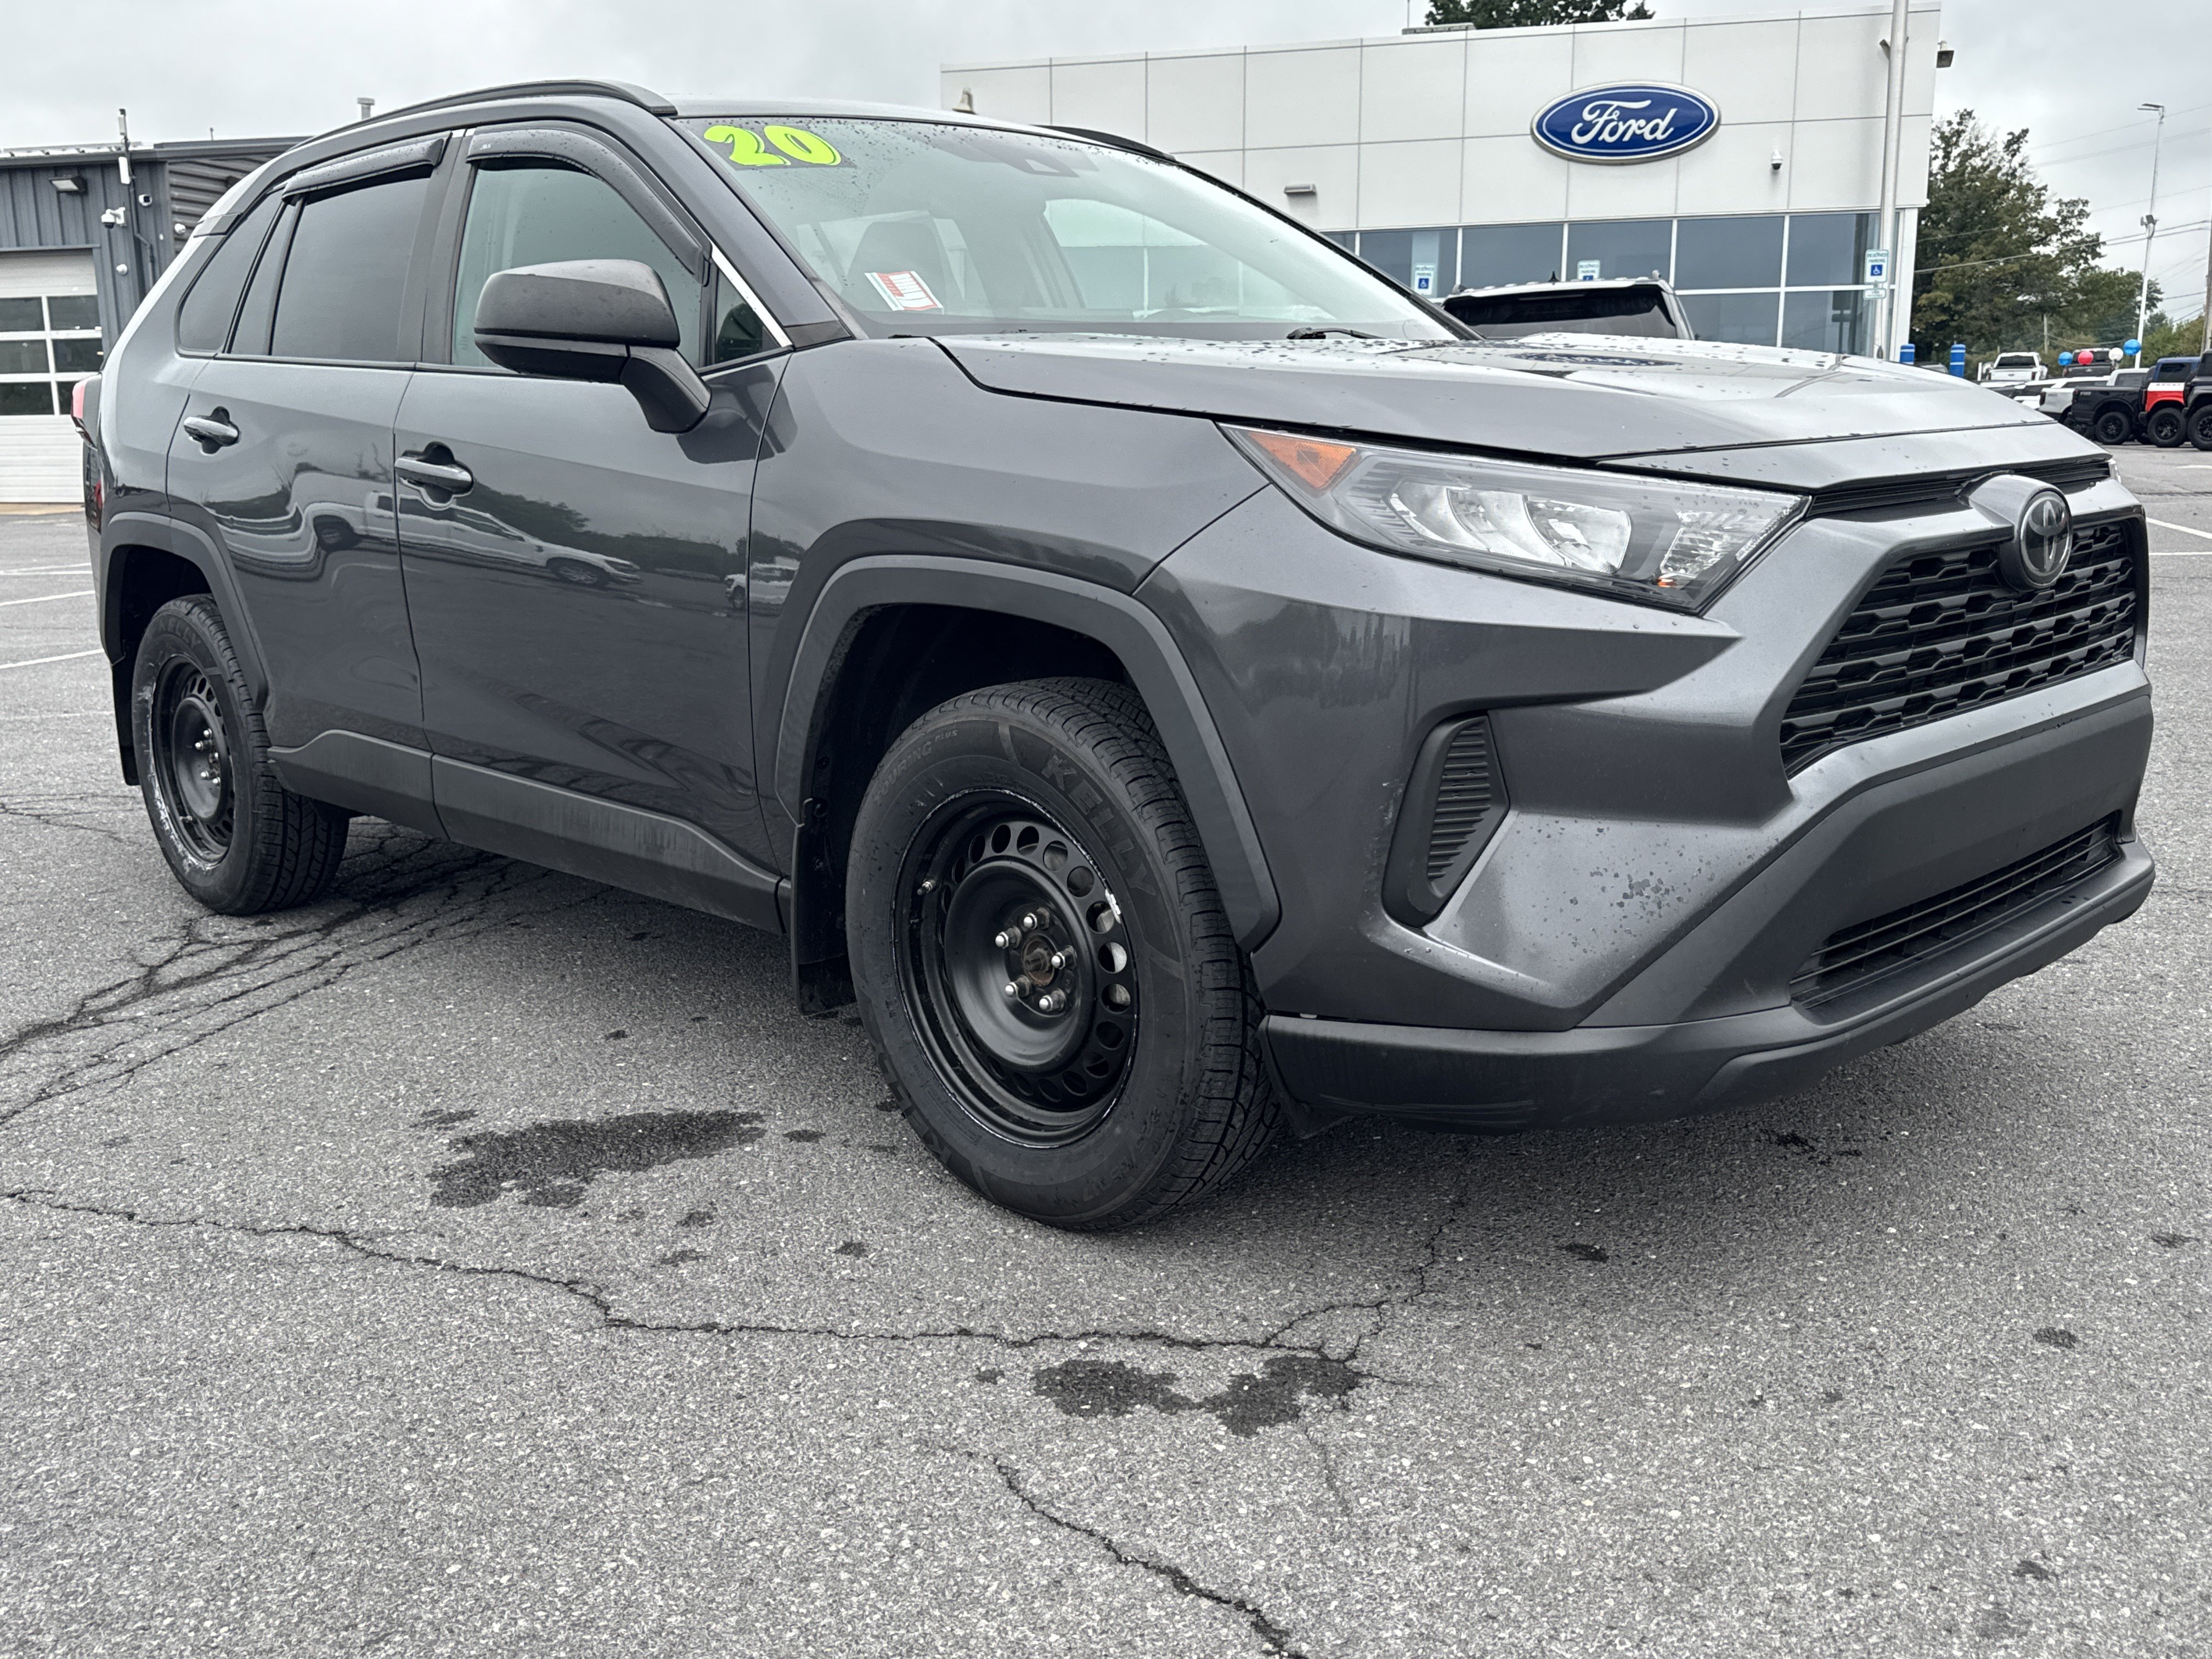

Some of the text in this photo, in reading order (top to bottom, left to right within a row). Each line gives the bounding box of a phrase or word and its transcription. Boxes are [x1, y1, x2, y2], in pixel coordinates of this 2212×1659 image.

[1571, 99, 1678, 144] Ford
[703, 125, 842, 166] 20
[160, 617, 201, 648] KELLY
[871, 729, 959, 803] TOURING PLUS
[1041, 753, 1156, 896] KELLY
